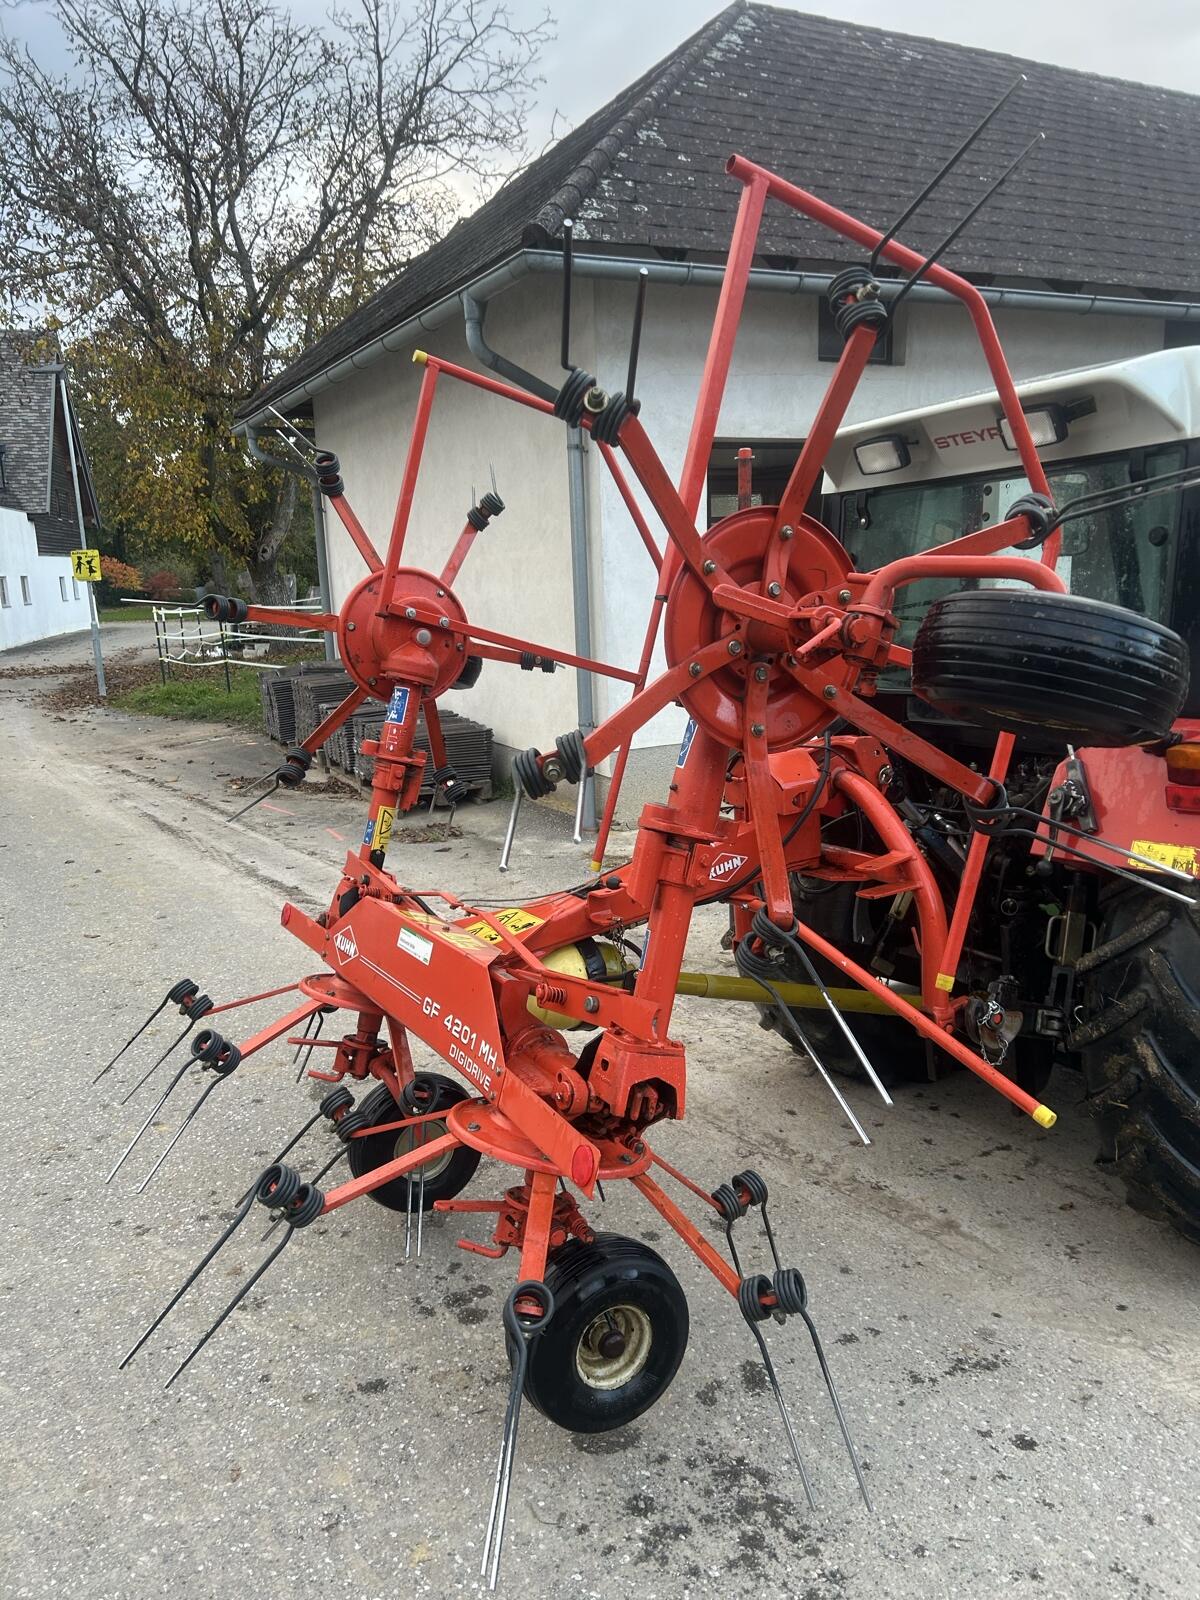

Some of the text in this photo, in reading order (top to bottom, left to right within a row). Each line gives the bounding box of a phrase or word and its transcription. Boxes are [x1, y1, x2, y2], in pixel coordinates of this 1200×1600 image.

[709, 856, 742, 878] KUHN
[336, 934, 356, 958] KUHN
[422, 996, 498, 1070] GF 4201 MH
[449, 1043, 491, 1092] DIGIDRIVE
